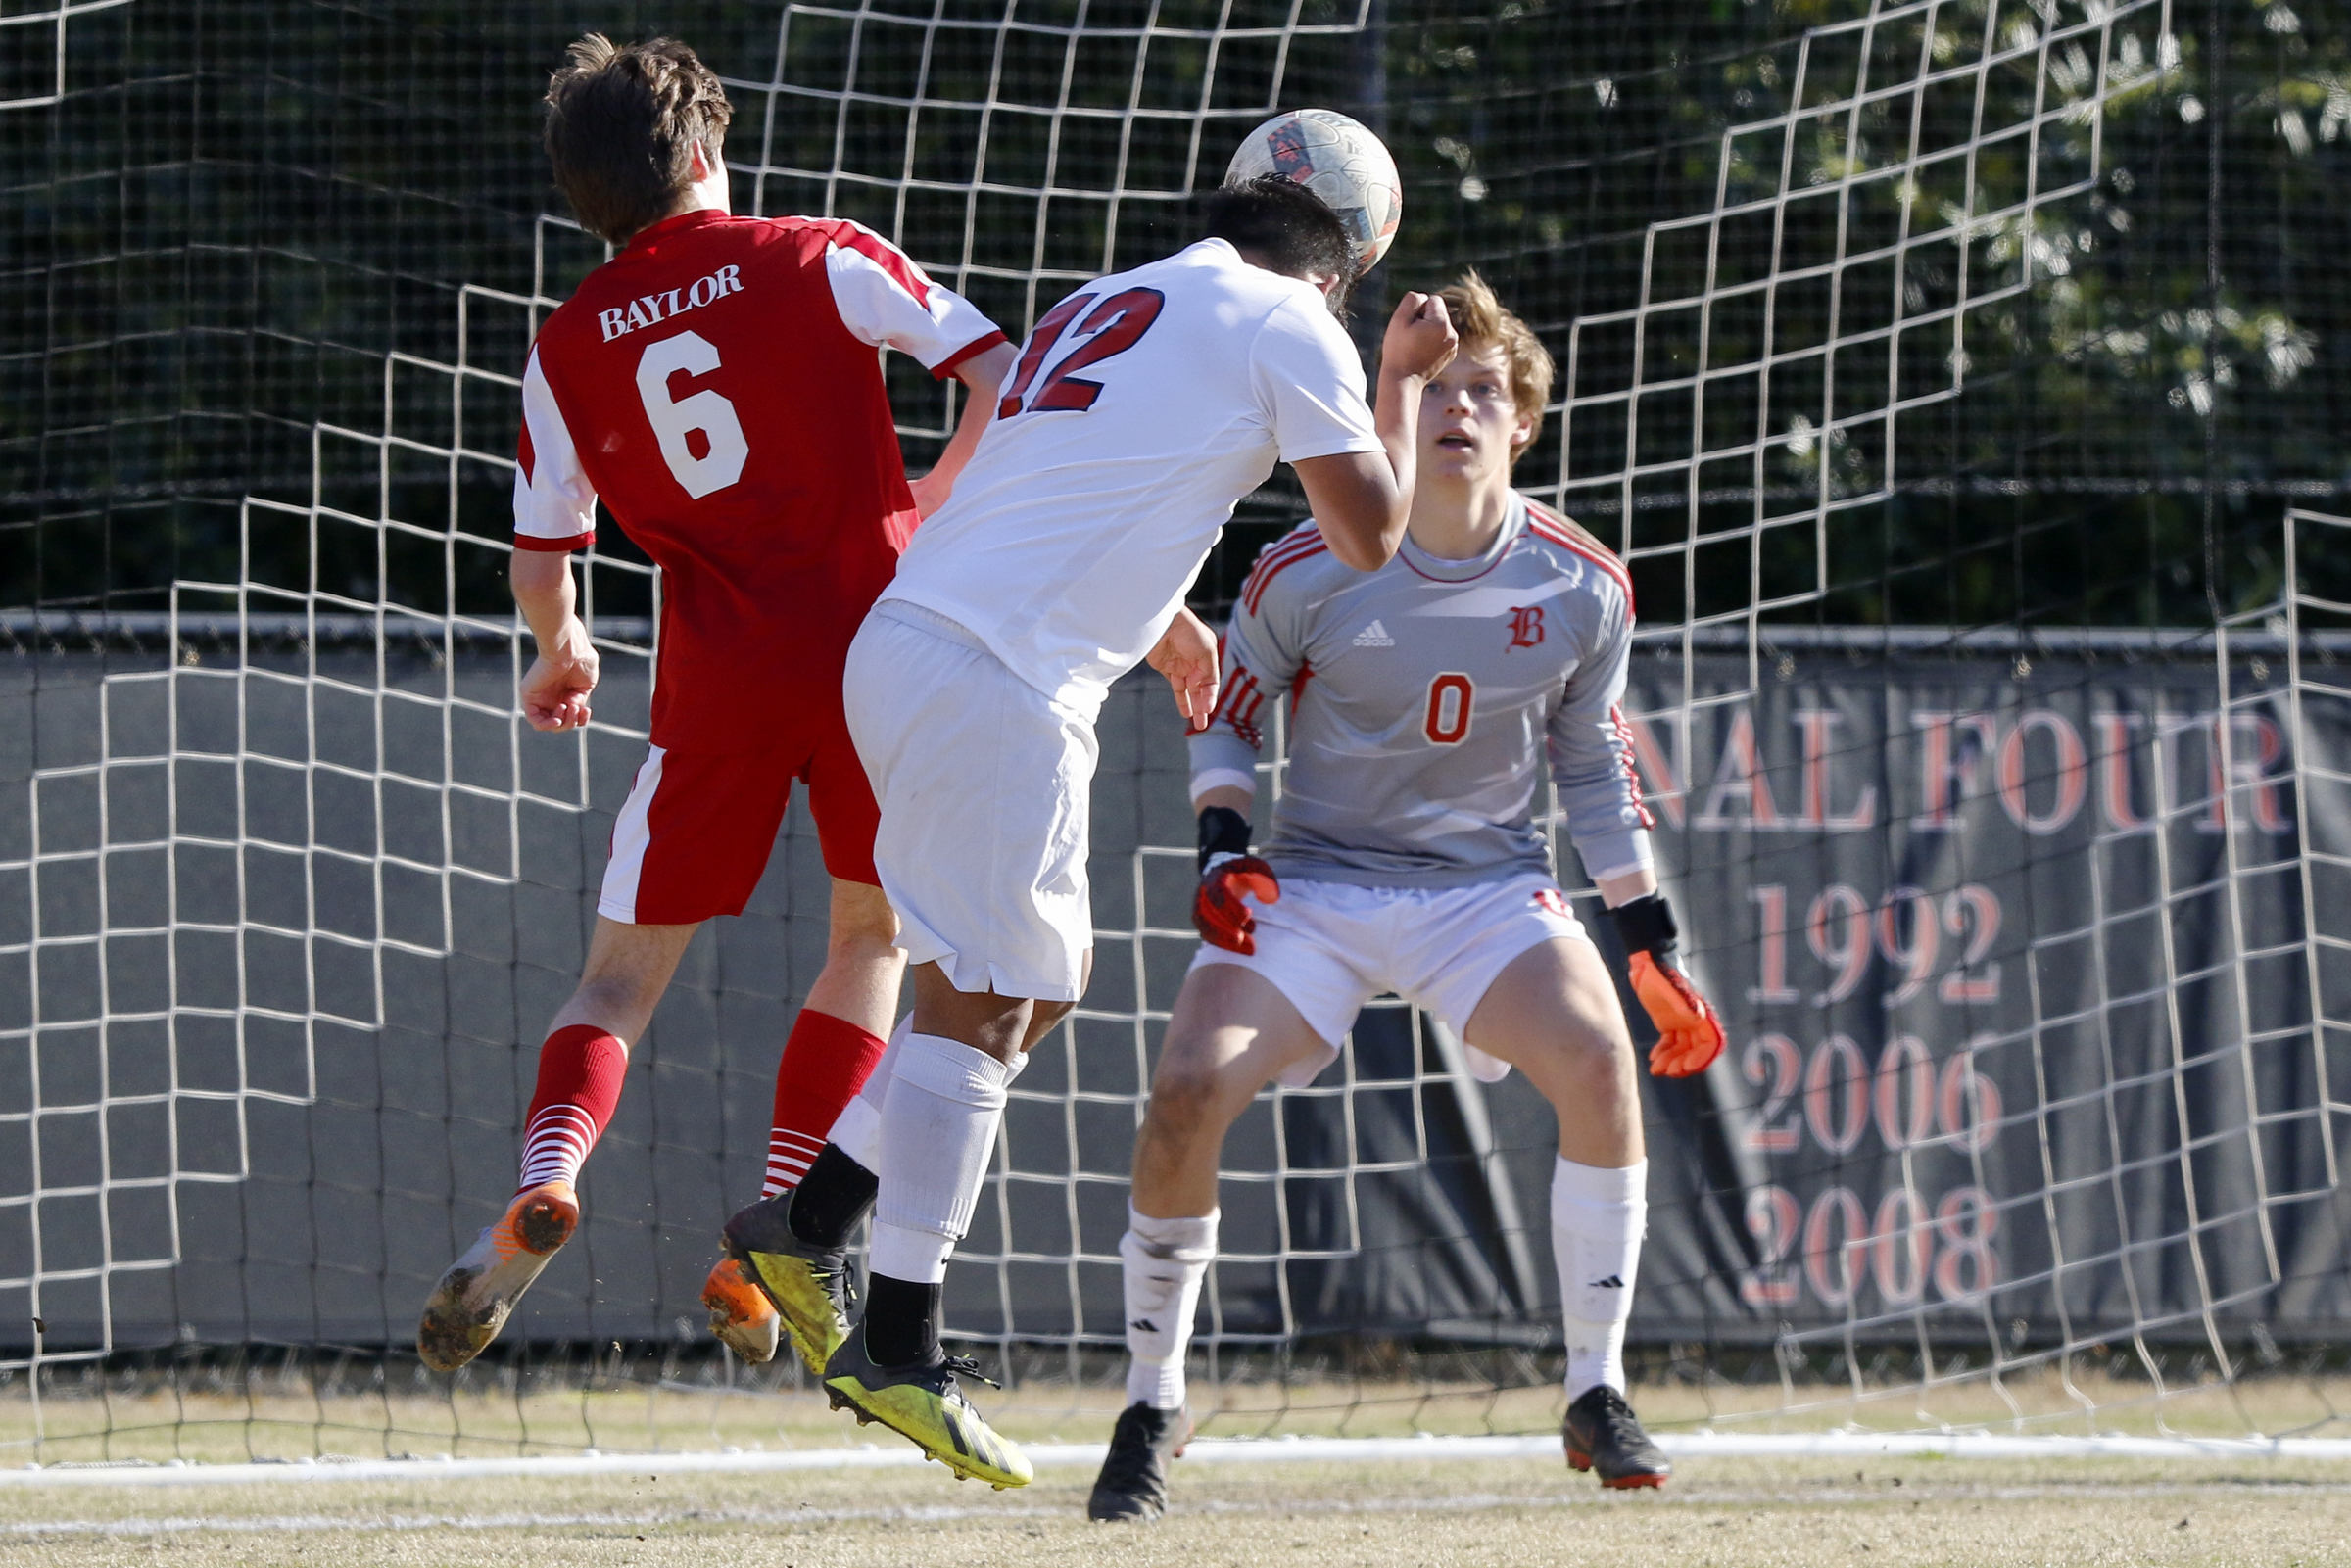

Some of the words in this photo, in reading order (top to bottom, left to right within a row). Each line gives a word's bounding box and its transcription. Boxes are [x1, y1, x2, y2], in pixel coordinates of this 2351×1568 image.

[598, 264, 744, 343] BAYLOR
[997, 286, 1166, 420] 12
[635, 329, 749, 500] 6
[1352, 638, 1396, 647] adidas
[1504, 606, 1545, 654] B
[1423, 671, 1476, 746] 0
[1624, 706, 1877, 832] NAL
[1910, 708, 2291, 835] FOUR
[1744, 883, 2002, 1008] 1992
[1741, 1033, 2002, 1154] 2006
[1740, 1186, 1999, 1307] 2008
